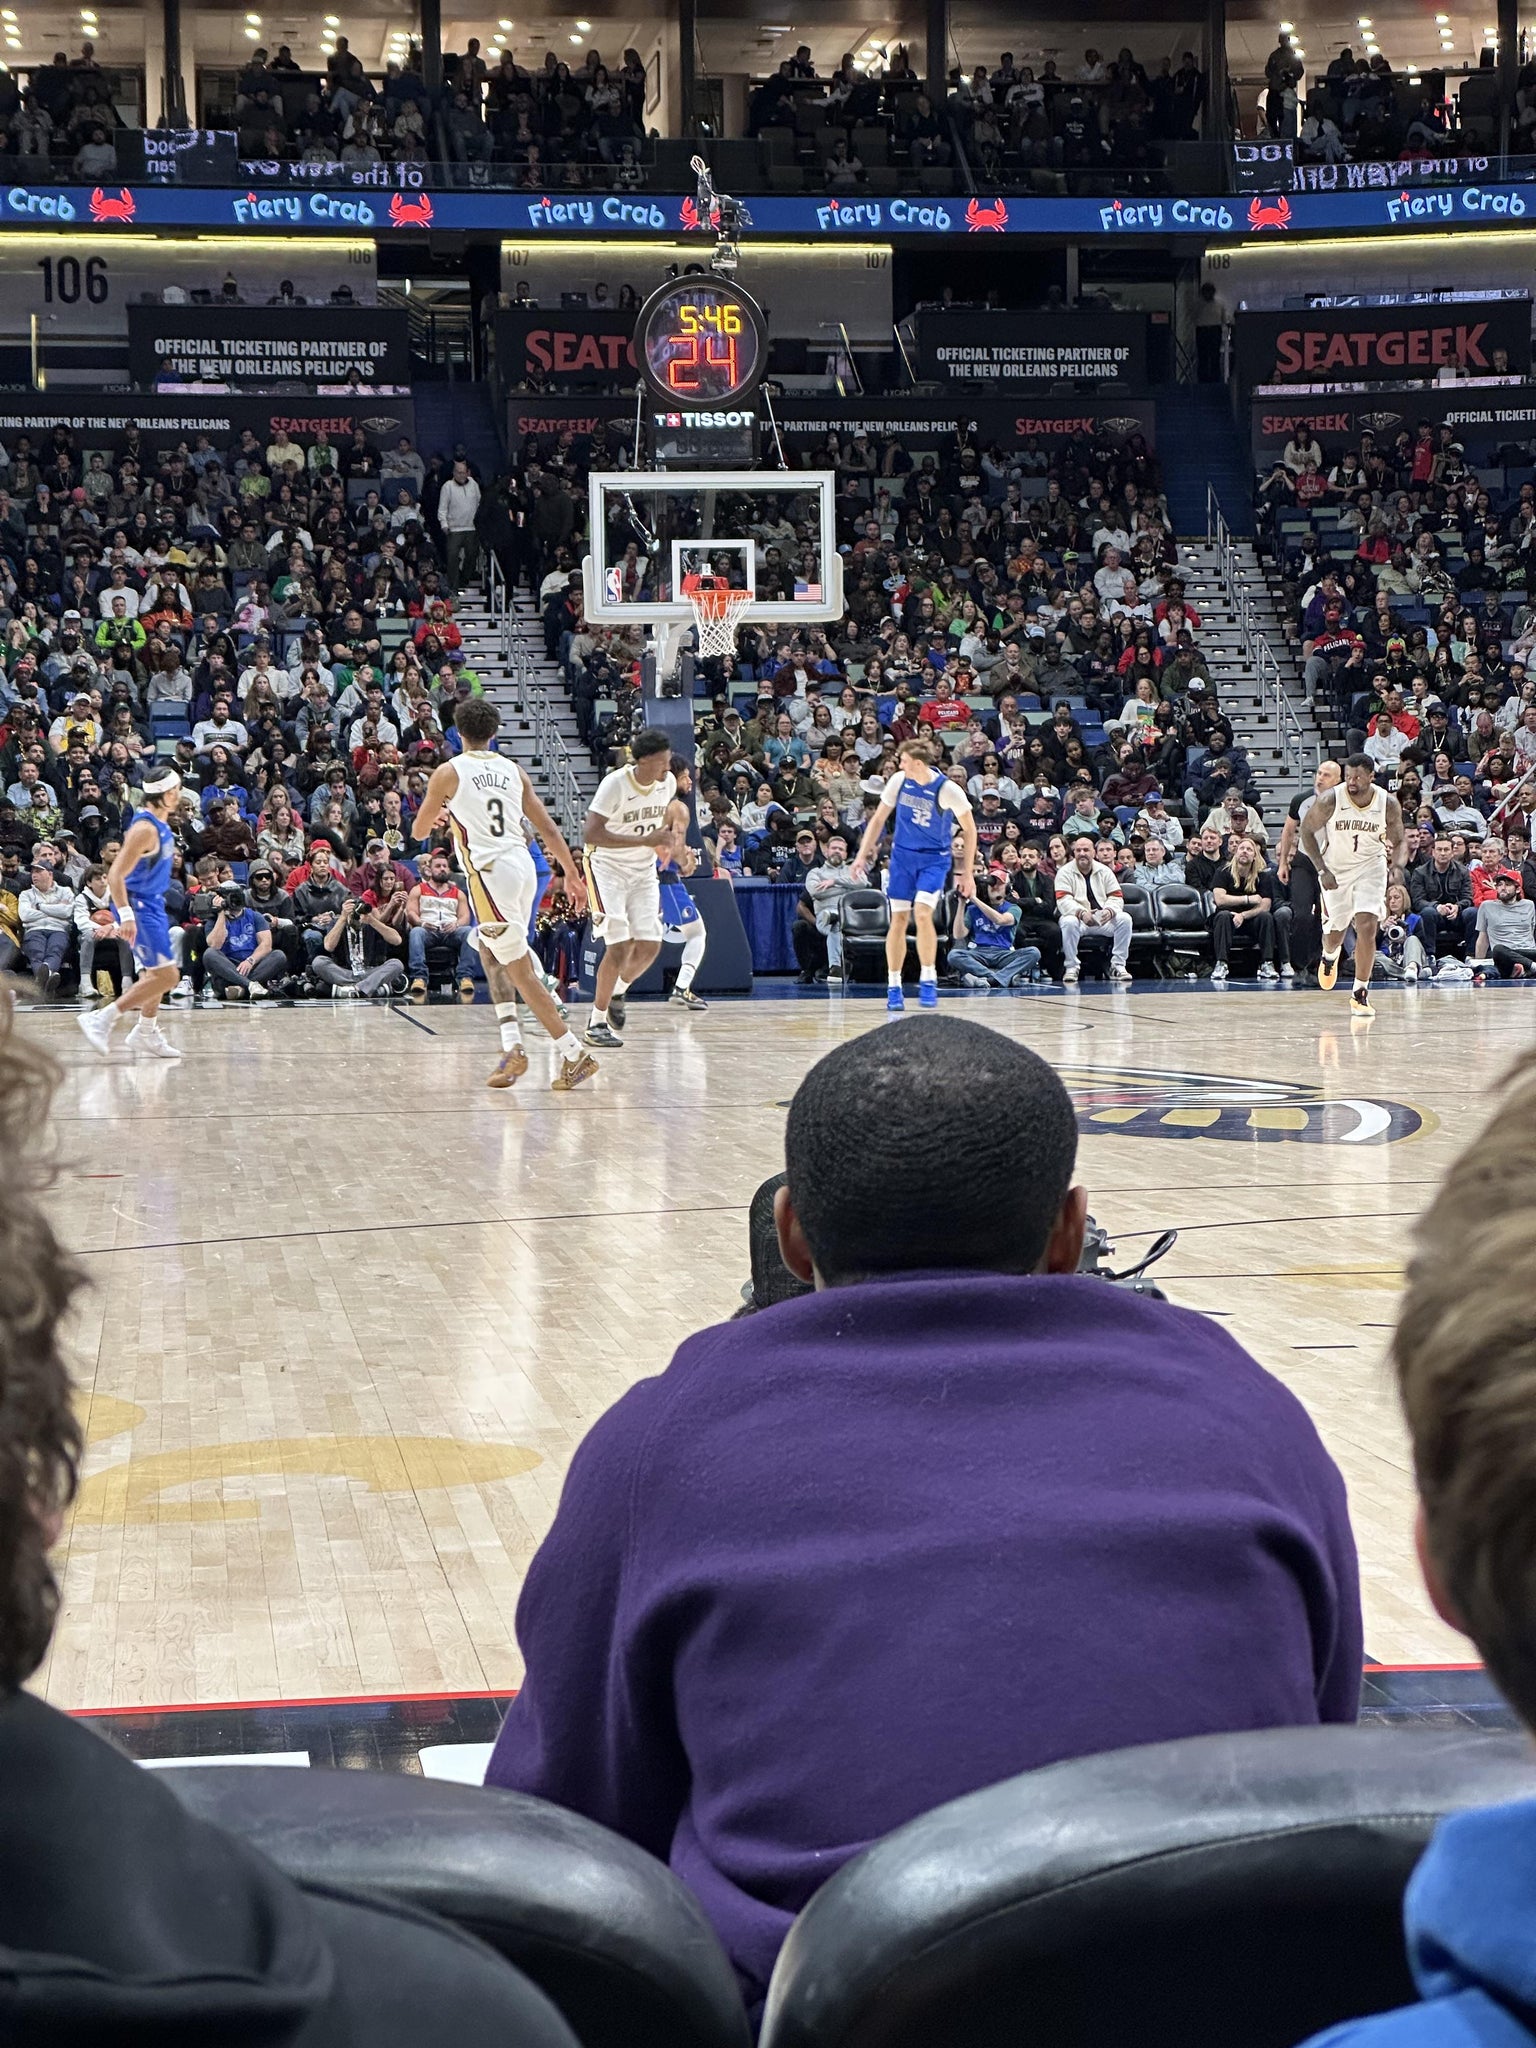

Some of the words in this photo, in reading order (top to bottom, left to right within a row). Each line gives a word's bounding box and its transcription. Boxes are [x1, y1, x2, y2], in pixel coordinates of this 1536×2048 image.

[7, 187, 76, 221] Crab
[234, 192, 301, 223] Fiery
[310, 193, 375, 226] Crab
[527, 197, 594, 228] Fiery
[603, 197, 666, 229] Crab
[1386, 191, 1453, 223] Fiery
[1462, 187, 1526, 217] Crab
[816, 199, 881, 230] Fiery
[890, 199, 951, 230] Crab
[1099, 200, 1163, 231] Fiery
[1172, 200, 1233, 230] Crab
[347, 248, 372, 265] 106
[506, 249, 530, 267] 107
[865, 253, 888, 269] 107
[1207, 254, 1231, 269] 108
[37, 256, 108, 304] 106
[680, 305, 742, 334] 5:46
[154, 339, 220, 355] OFFICIAL
[221, 340, 298, 356] TICKETING
[301, 341, 367, 357] PARTNER
[369, 342, 388, 357] OF
[936, 348, 990, 361] OFFICIAL
[992, 348, 1055, 361] TICKETING
[1057, 348, 1111, 361] PARTNER
[1113, 348, 1129, 361] OF
[1276, 322, 1490, 375] SEATGEEK
[171, 359, 197, 374] THE
[200, 360, 232, 375] NEW
[235, 360, 302, 375] ORLEANS
[304, 360, 375, 376] PELICANS
[667, 336, 738, 389] 24
[949, 364, 971, 377] THE
[973, 364, 1000, 377] NEW
[1002, 364, 1058, 377] ORLEANS
[1060, 364, 1119, 377] PELICANS
[72, 418, 87, 428] OF
[87, 418, 106, 429] THE
[181, 419, 230, 430] PELICANS
[270, 417, 352, 434] SEATGEEK
[682, 412, 755, 427] TISSOT
[1446, 410, 1493, 424] OFFICIAL
[1495, 409, 1536, 422] TICKETI
[784, 421, 828, 432] PARTNER
[843, 421, 862, 431] THE
[863, 421, 884, 432] NEW
[885, 421, 930, 432] ORLEANS
[931, 421, 978, 432] PELICS
[472, 773, 510, 791] POOLE
[487, 798, 505, 837] 3
[622, 809, 639, 823] NEW
[911, 808, 932, 828] 32
[1335, 820, 1351, 831] NEW
[1351, 820, 1380, 833] ORLEANS
[1352, 834, 1359, 853] 1
